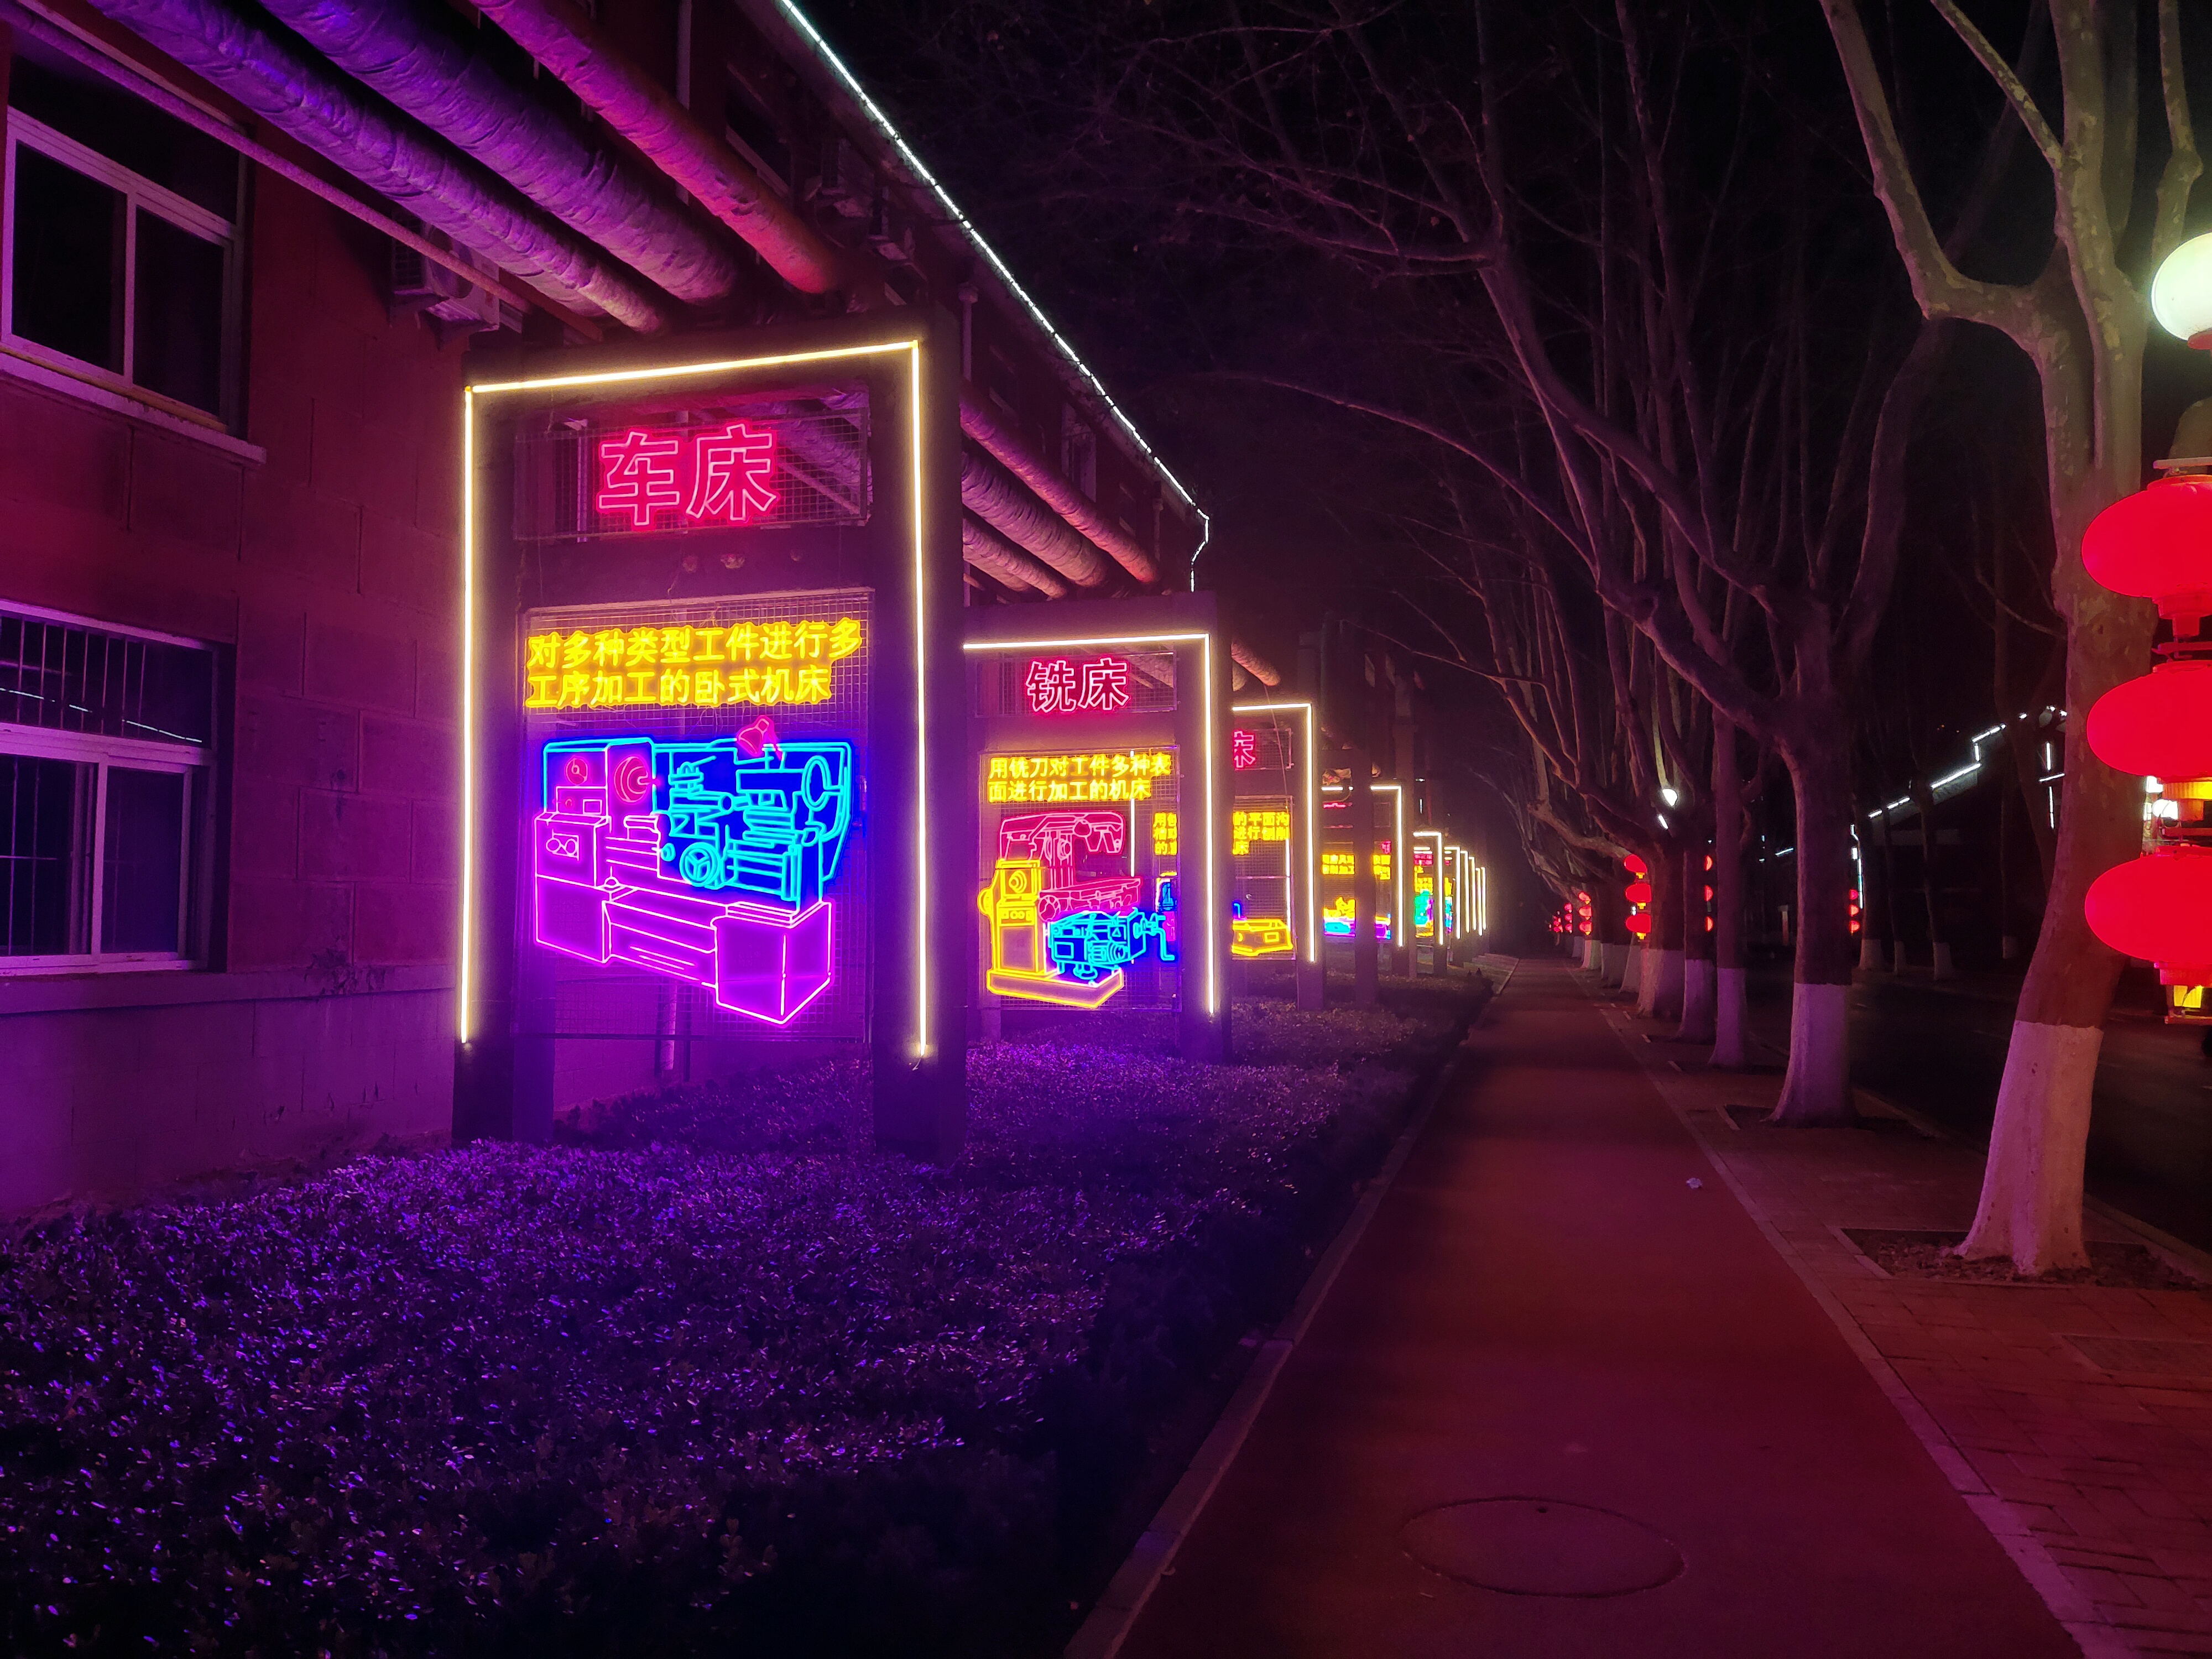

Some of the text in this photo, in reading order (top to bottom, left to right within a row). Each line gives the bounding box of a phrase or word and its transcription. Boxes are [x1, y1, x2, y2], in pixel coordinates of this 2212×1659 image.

[597, 422, 778, 526] 车床
[527, 617, 861, 668] 对多种类型工件进行多
[525, 667, 832, 707] 工序加工的卧式机床
[1025, 656, 1130, 713] 铣床
[989, 753, 1171, 779] 用铣刀对工件多种表
[988, 778, 1152, 803] 面进行加工的机床
